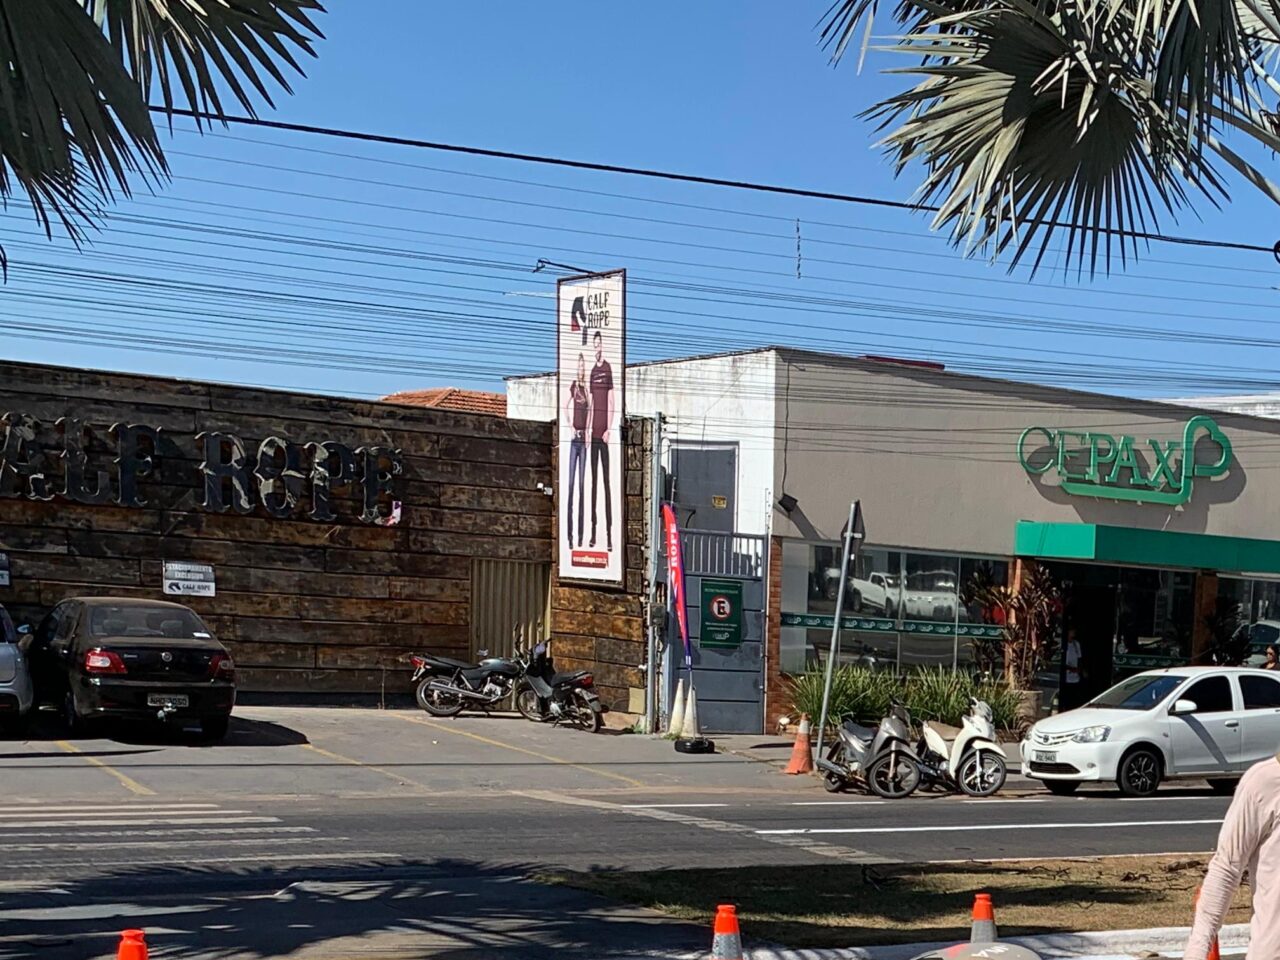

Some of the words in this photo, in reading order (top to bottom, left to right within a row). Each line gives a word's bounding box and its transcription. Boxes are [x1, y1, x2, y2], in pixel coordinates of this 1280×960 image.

[587, 292, 609, 310] CALF
[587, 311, 610, 328] ROPE
[1018, 426, 1184, 488] CEPAX
[195, 431, 402, 526] ROPE
